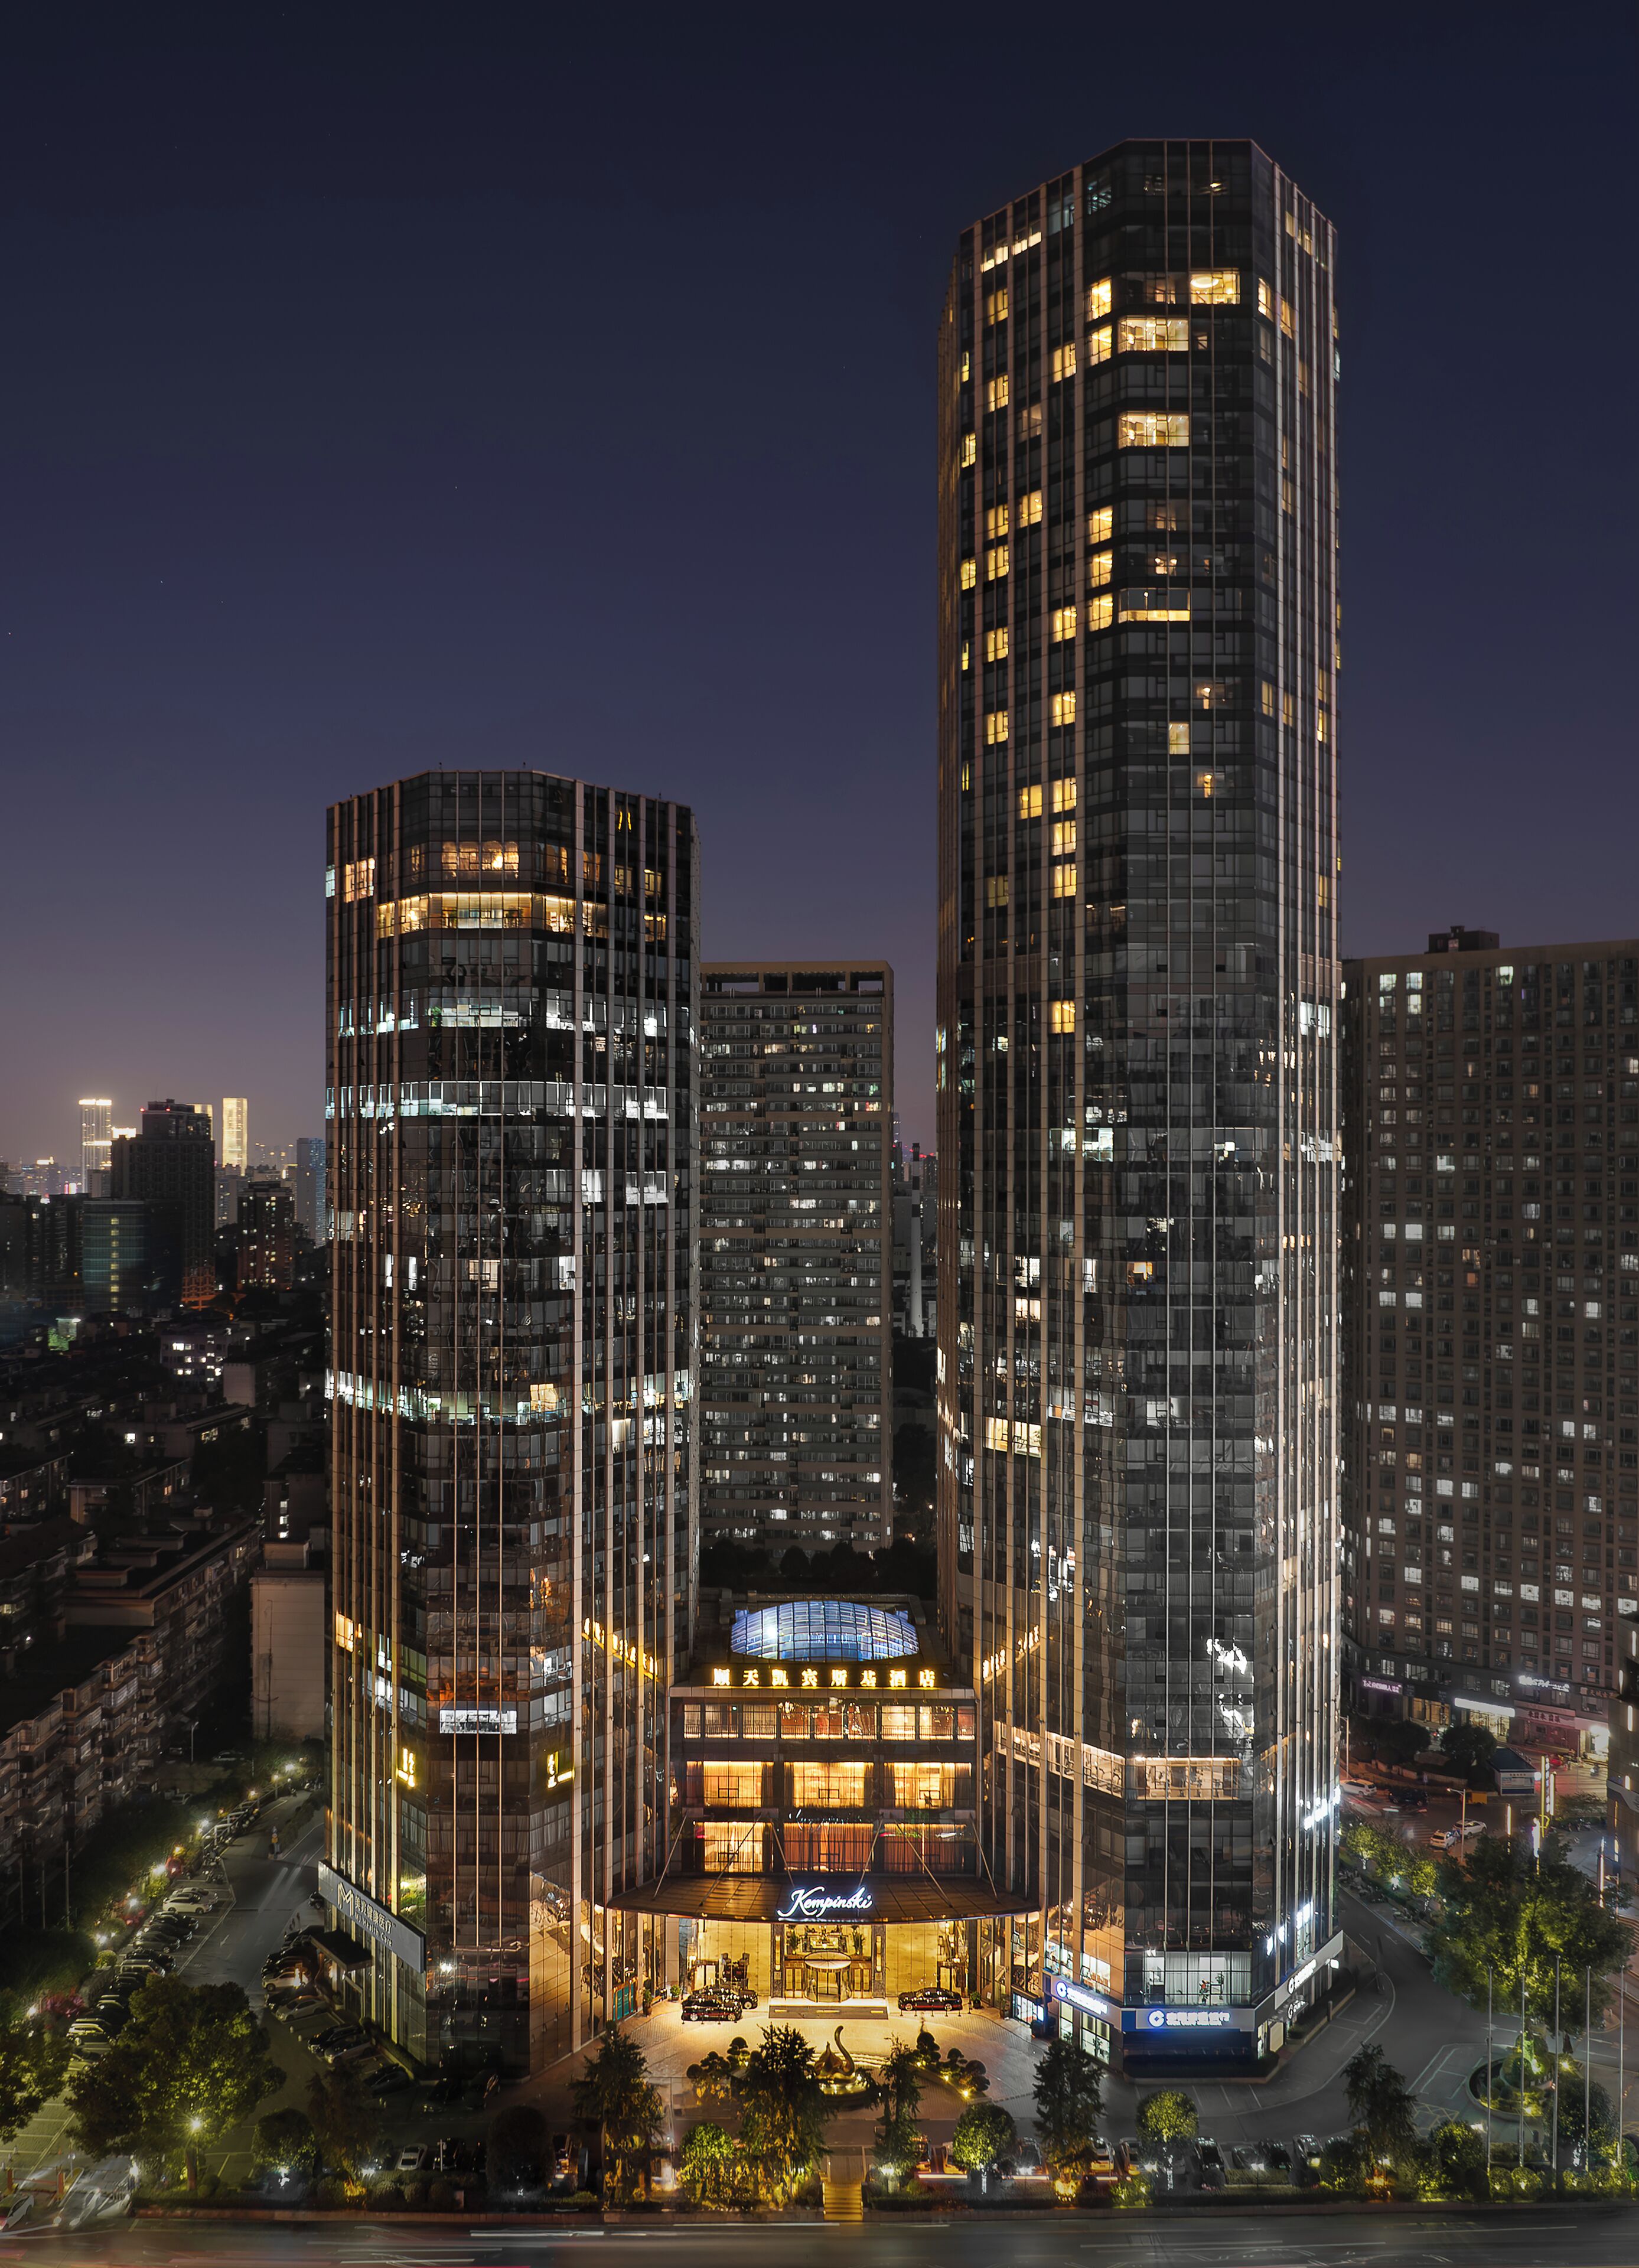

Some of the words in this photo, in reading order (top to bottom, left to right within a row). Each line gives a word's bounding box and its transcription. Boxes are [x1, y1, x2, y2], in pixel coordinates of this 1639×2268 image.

[777, 1886, 873, 1918] Kempinski
[363, 1918, 379, 1937] Health
[381, 1932, 392, 1947] Care
